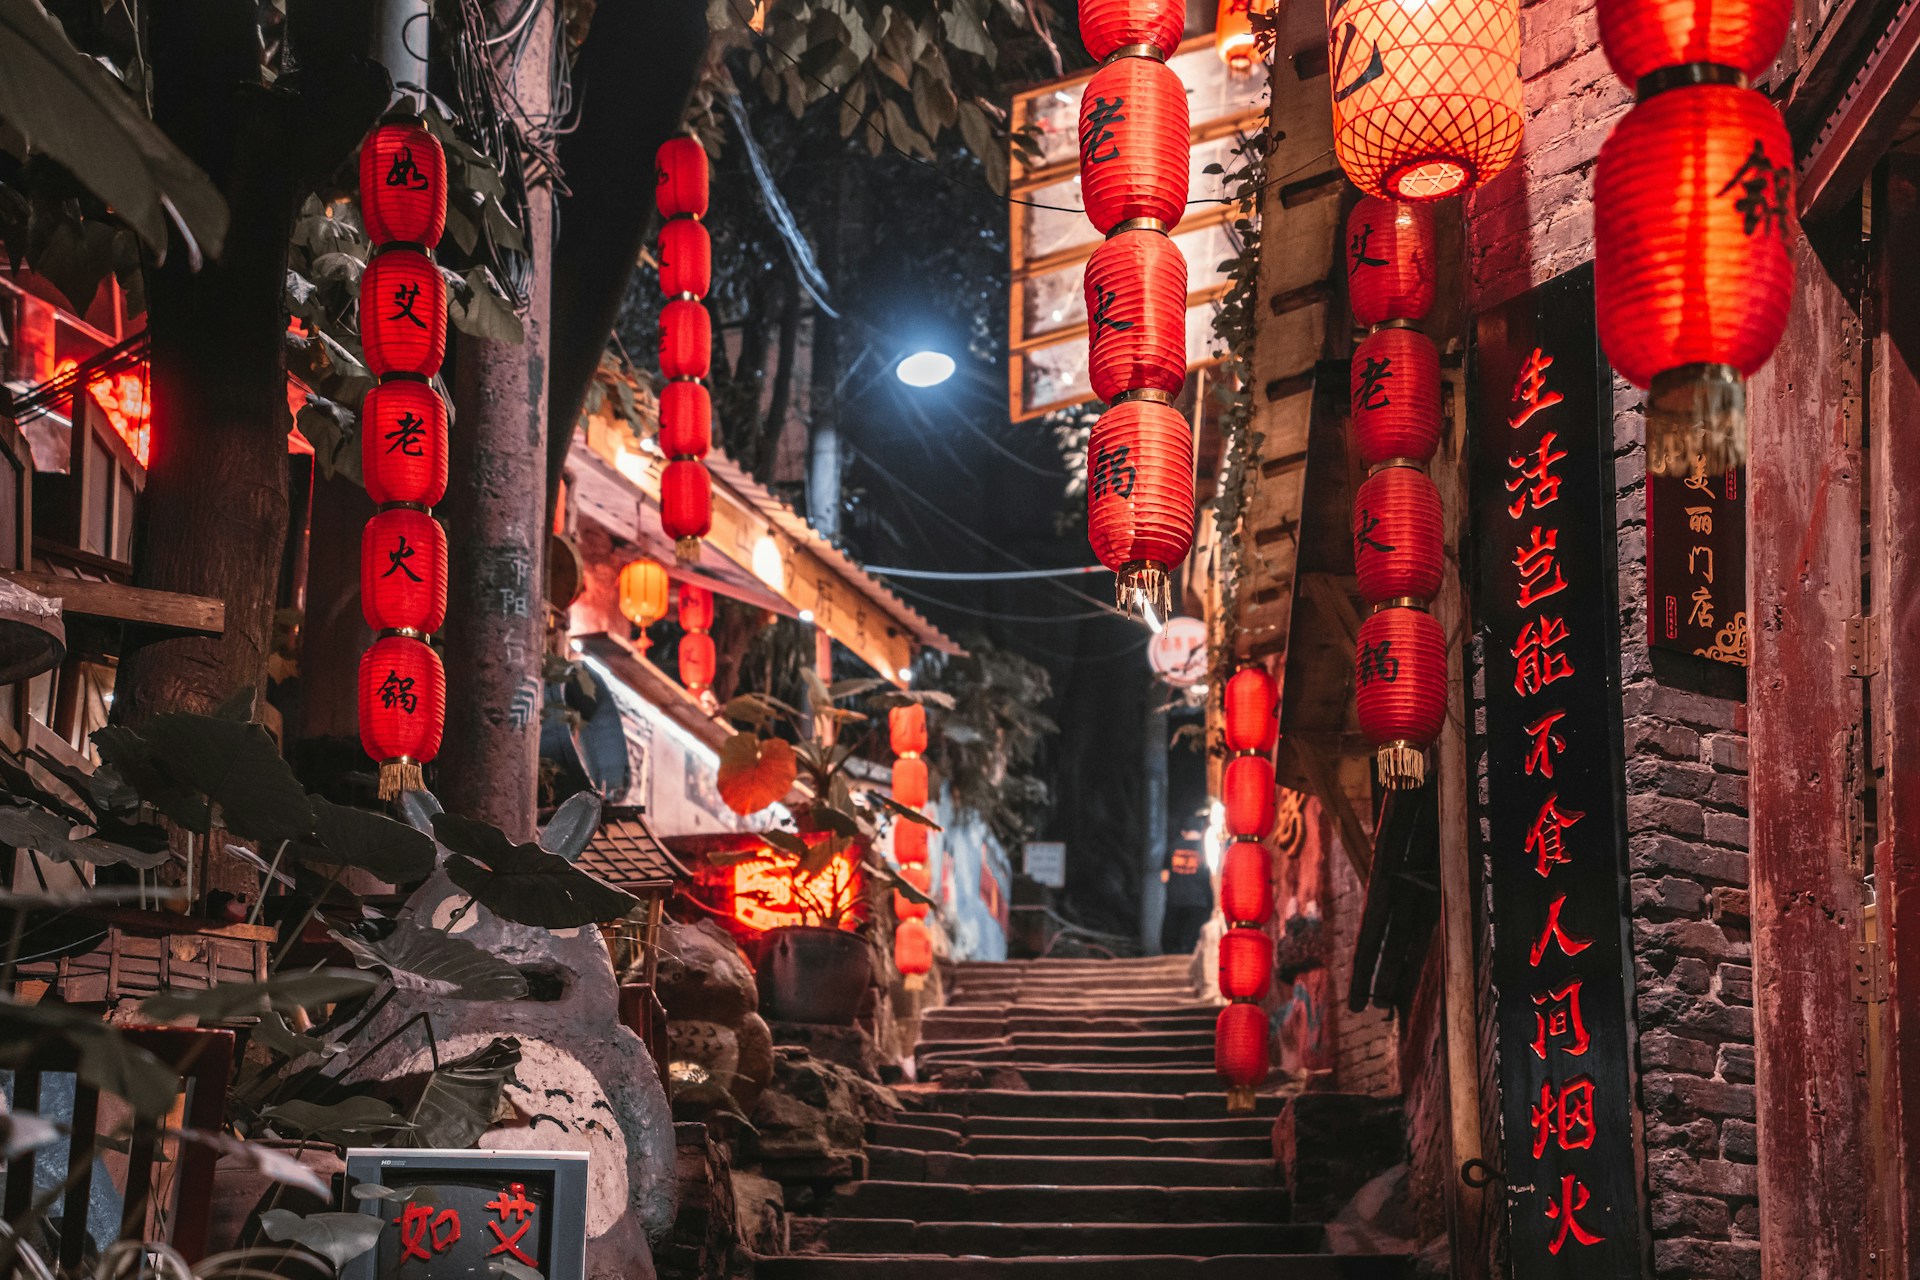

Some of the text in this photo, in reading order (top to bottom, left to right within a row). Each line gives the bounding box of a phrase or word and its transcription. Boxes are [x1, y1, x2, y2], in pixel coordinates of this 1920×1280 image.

[1504, 346, 1607, 1257] 生活岂能不食人间烟火
